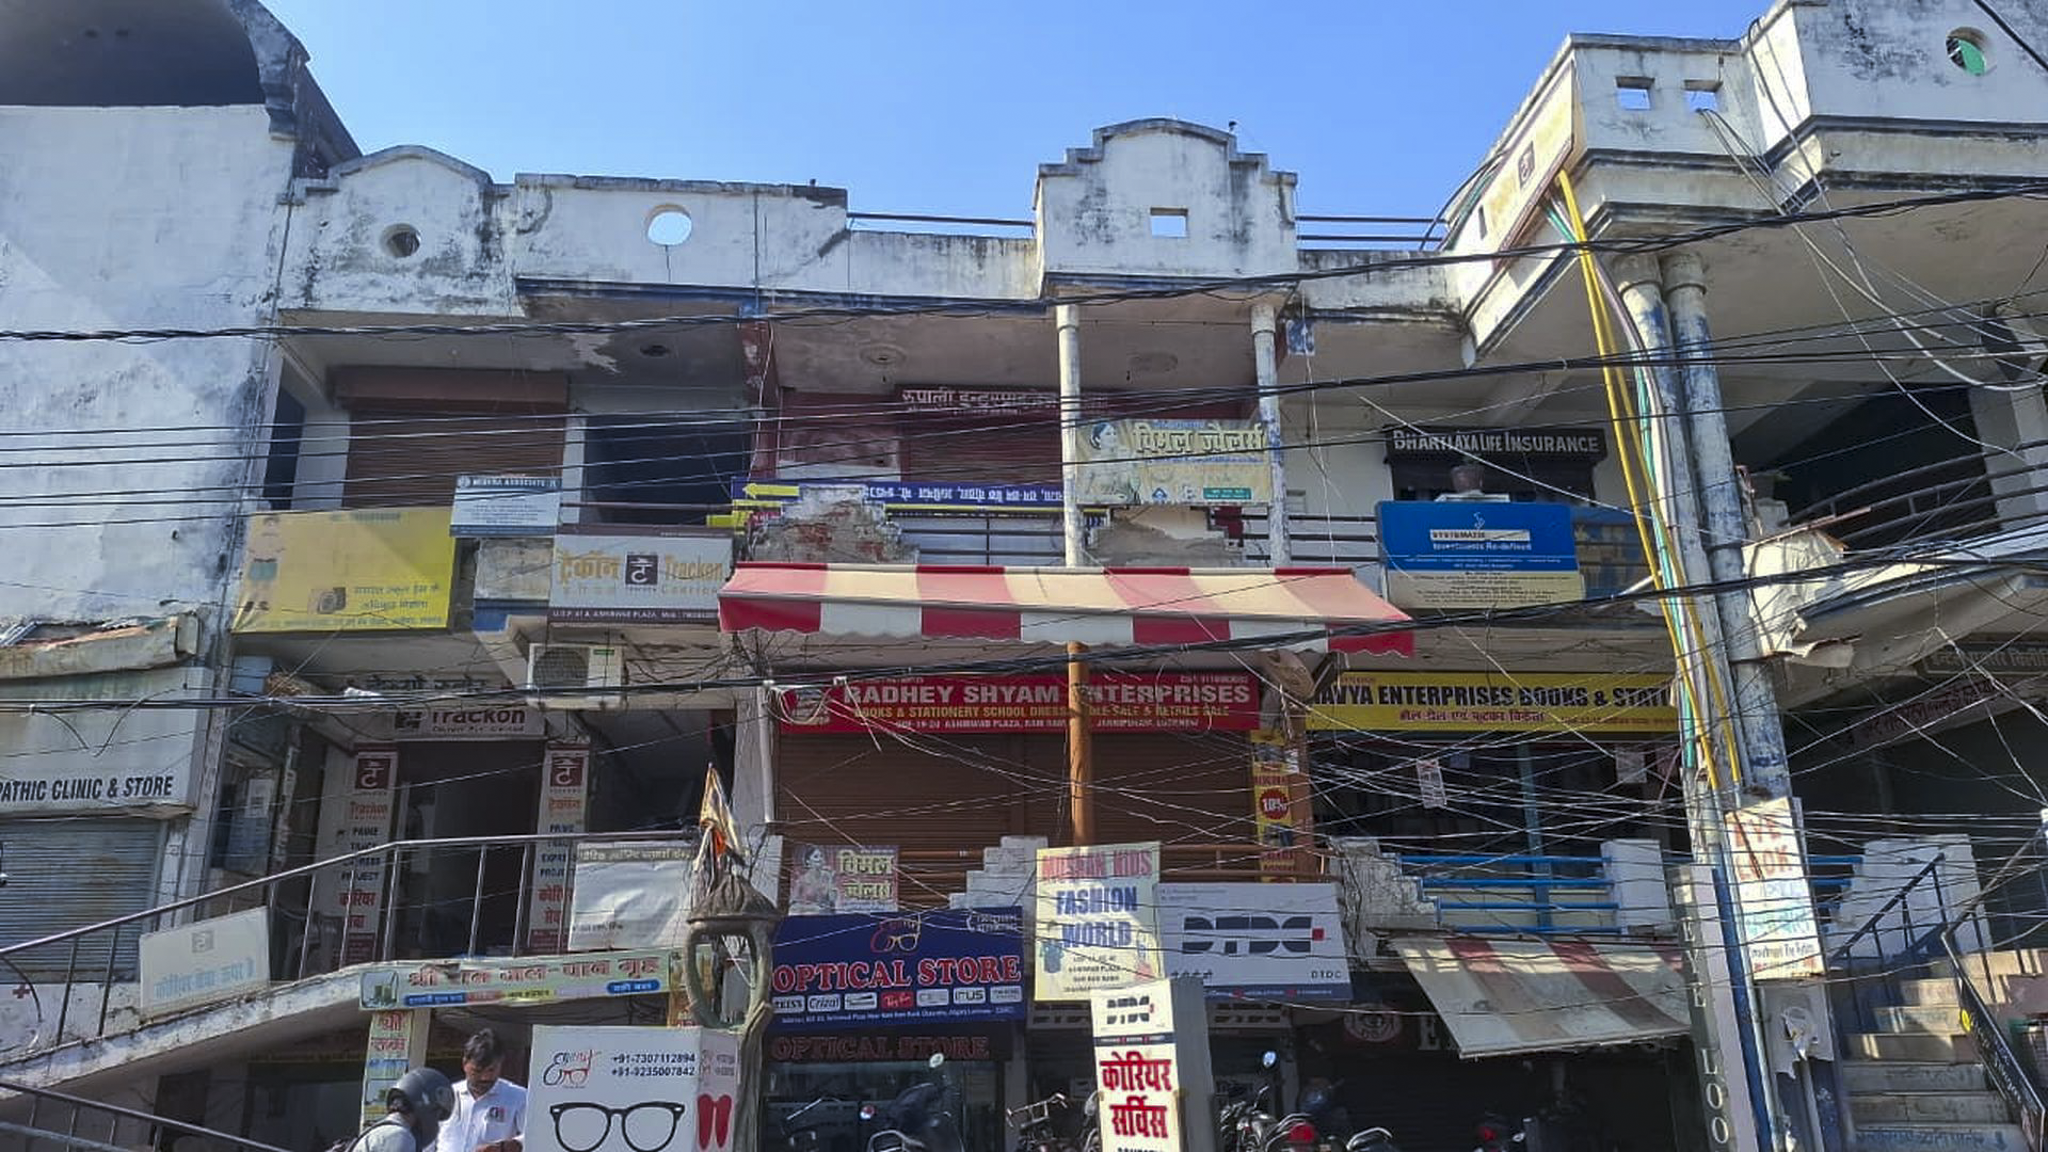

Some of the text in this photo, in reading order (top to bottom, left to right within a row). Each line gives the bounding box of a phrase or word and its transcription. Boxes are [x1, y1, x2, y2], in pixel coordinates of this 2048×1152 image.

[1505, 431, 1598, 451] INSURANCE
[843, 684, 1250, 703] RADHEY SHYAM NTERPRISES
[1378, 686, 1513, 706] ENTERPRISES
[1519, 686, 1587, 706] BOOKS
[1594, 690, 1608, 706] &
[432, 709, 526, 724] Trackon
[909, 706, 980, 718] STATIONERY
[983, 706, 1026, 718] SCHOOL
[52, 778, 103, 800] CLINIC
[107, 777, 119, 798] &
[123, 776, 174, 797] STORE
[1057, 887, 1137, 915] FASHION
[1062, 922, 1131, 948] WORLD
[1182, 916, 1312, 954] DTDC
[772, 955, 1022, 992] OPTICAL STORE
[772, 1036, 990, 1060] OPTICAL STORE
[1099, 1051, 1172, 1092] कोरियर
[1109, 1095, 1169, 1139] सर्विस
